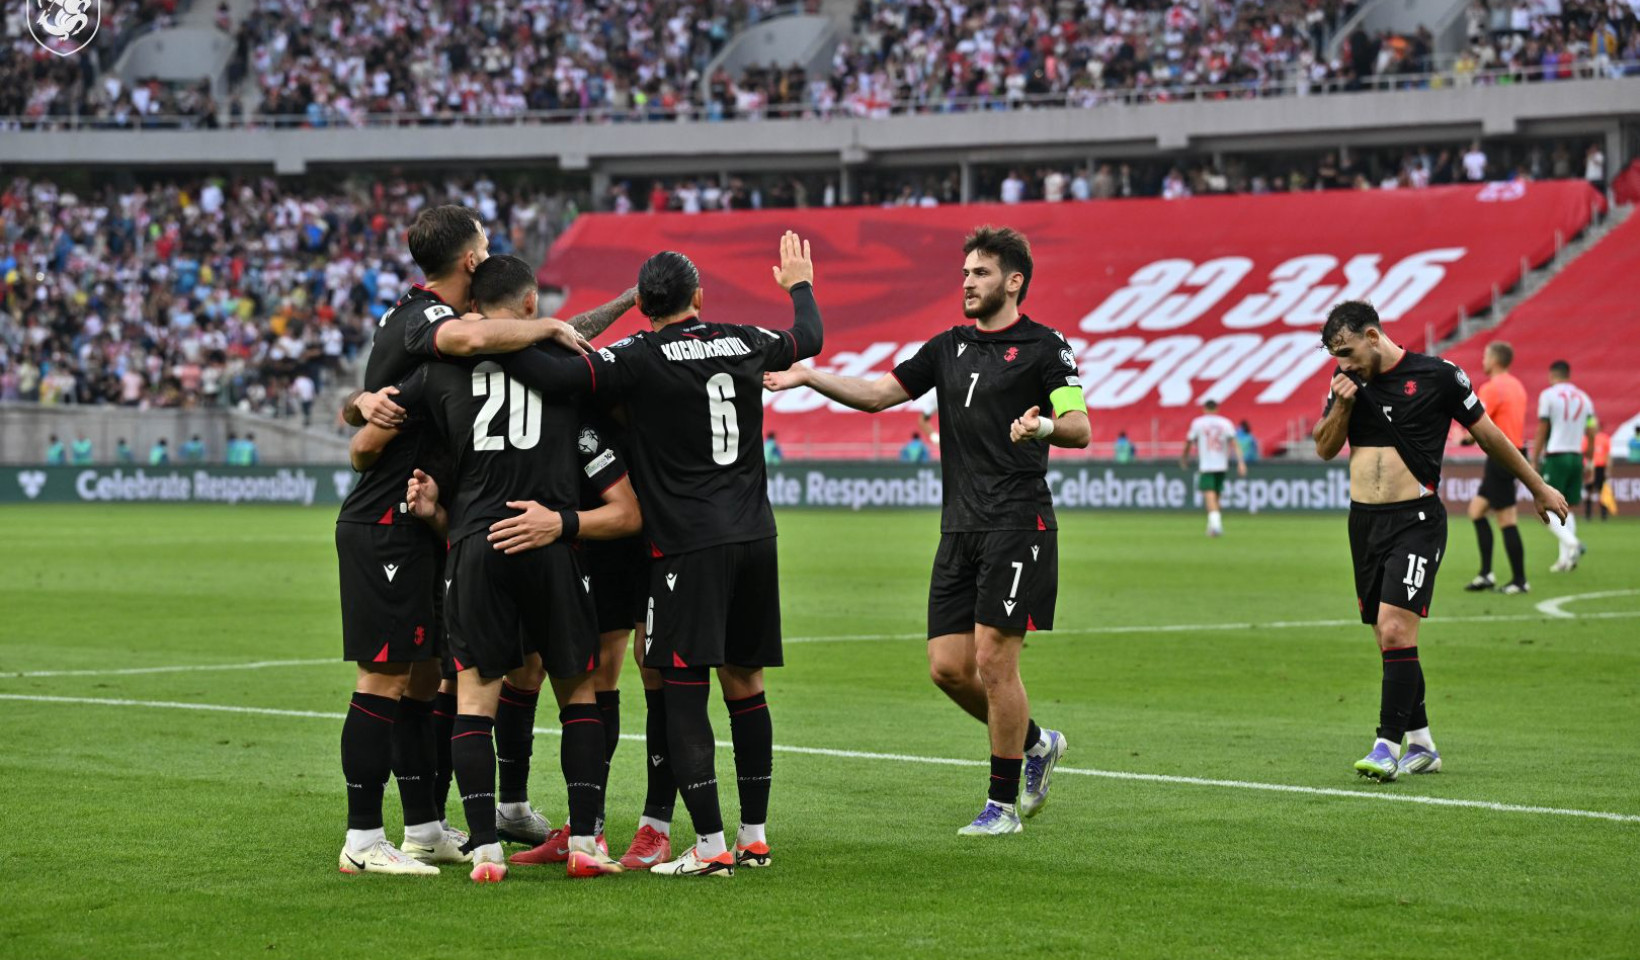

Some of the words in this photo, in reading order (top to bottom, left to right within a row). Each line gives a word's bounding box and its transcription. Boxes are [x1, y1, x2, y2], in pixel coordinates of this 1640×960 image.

[472, 360, 543, 452] 20
[964, 372, 980, 407] 7
[1558, 391, 1584, 422] 17
[706, 372, 740, 466] 6
[76, 470, 190, 500] Celebrate
[194, 469, 317, 505] Responsibly
[806, 469, 943, 510] Responsib
[1009, 561, 1024, 599] 7
[1402, 553, 1428, 589] 15
[645, 596, 655, 636] 6
